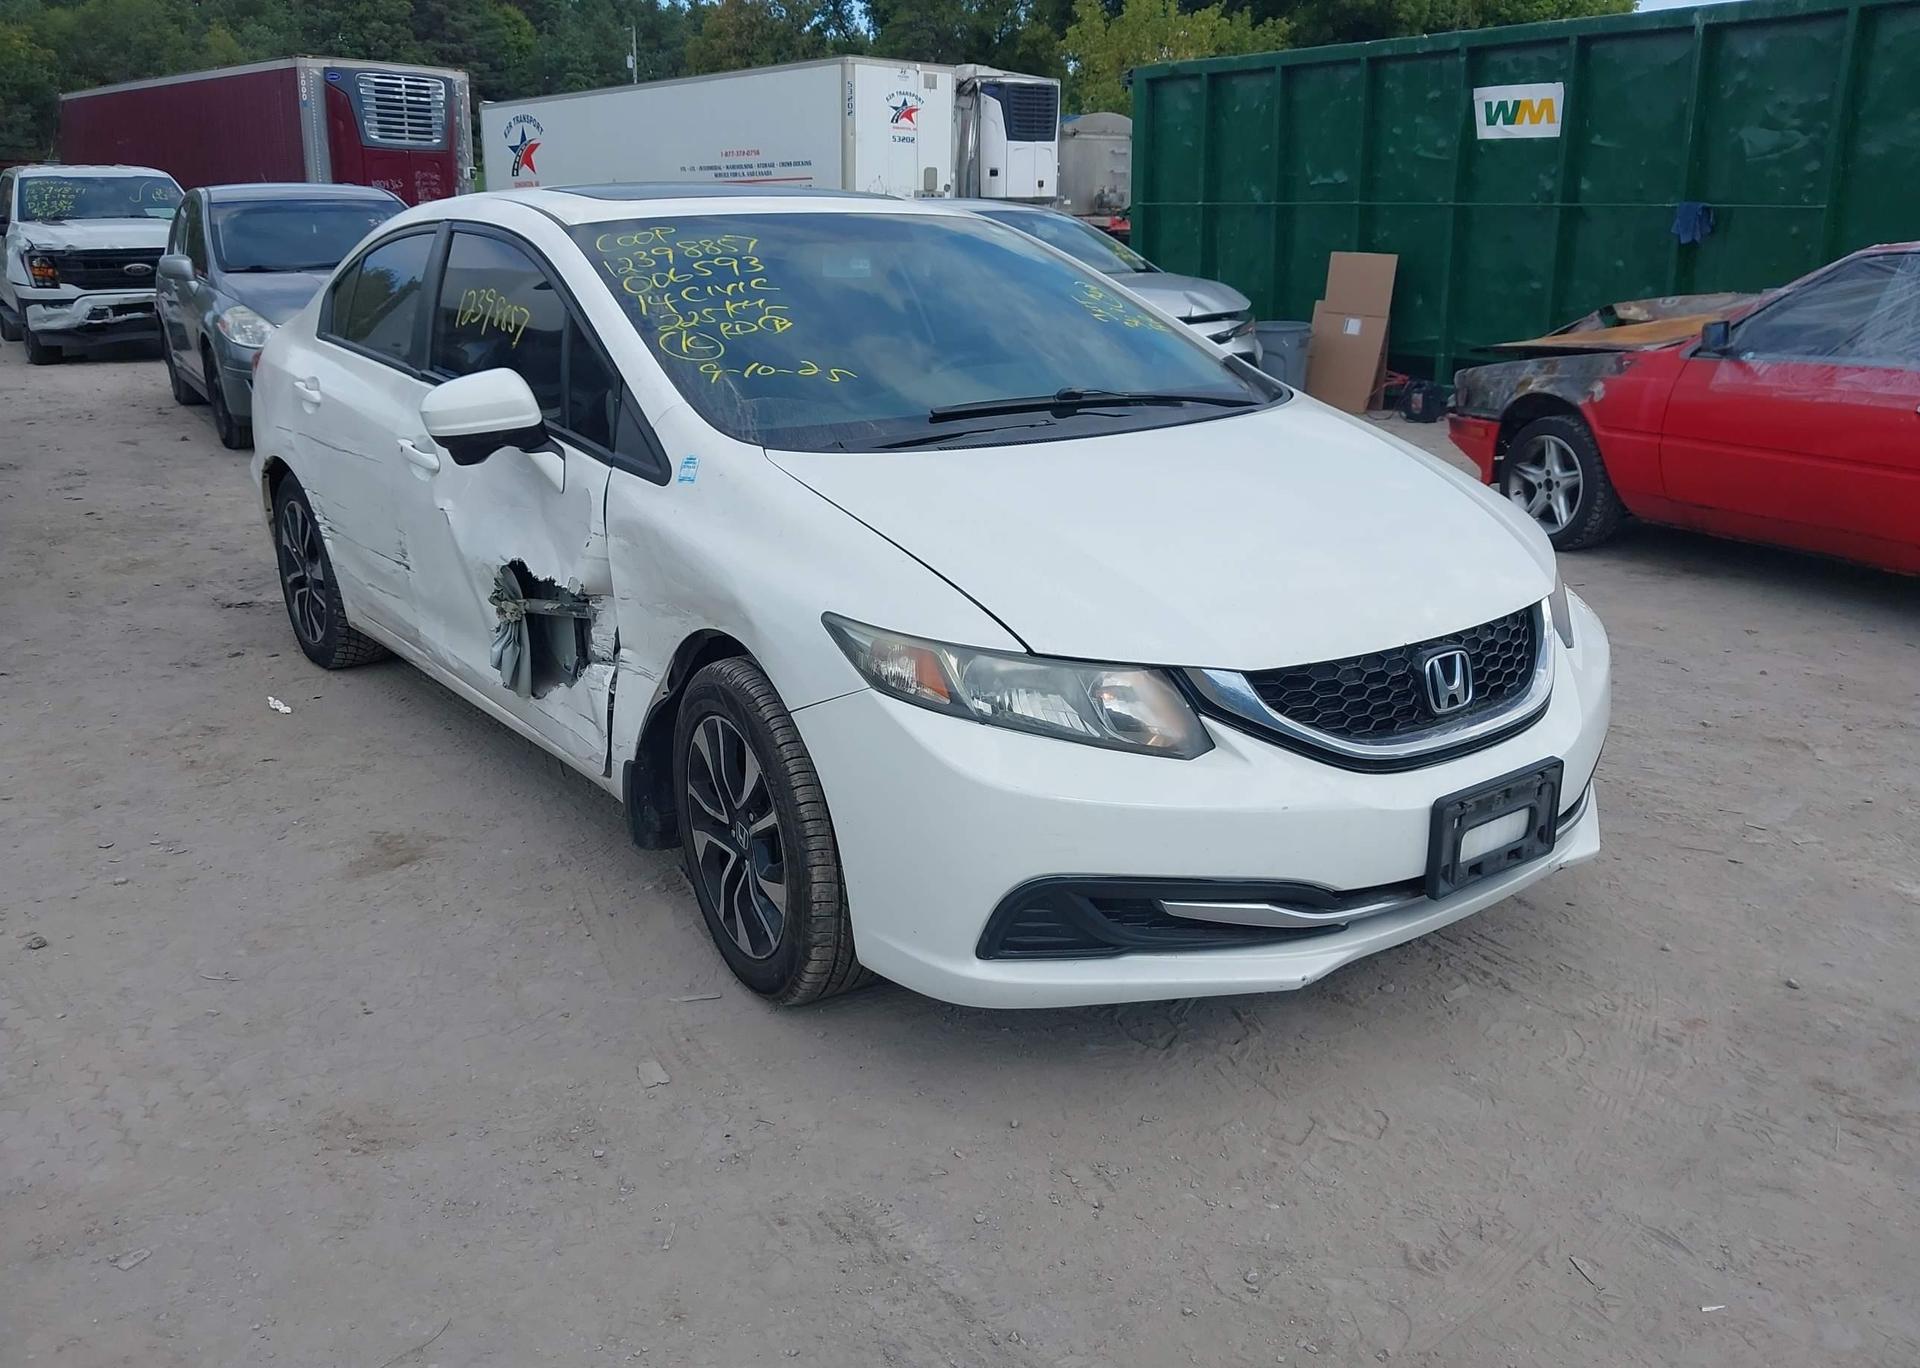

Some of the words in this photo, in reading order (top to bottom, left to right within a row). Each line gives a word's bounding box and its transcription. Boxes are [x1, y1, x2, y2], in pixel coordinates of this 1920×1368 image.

[895, 90, 925, 105] TRANSPORT
[1484, 98, 1556, 126] WM
[512, 113, 544, 136] TRANSPORT
[891, 135, 915, 144] 53202
[596, 226, 676, 252] COOP
[699, 361, 858, 383] 9-10-25
